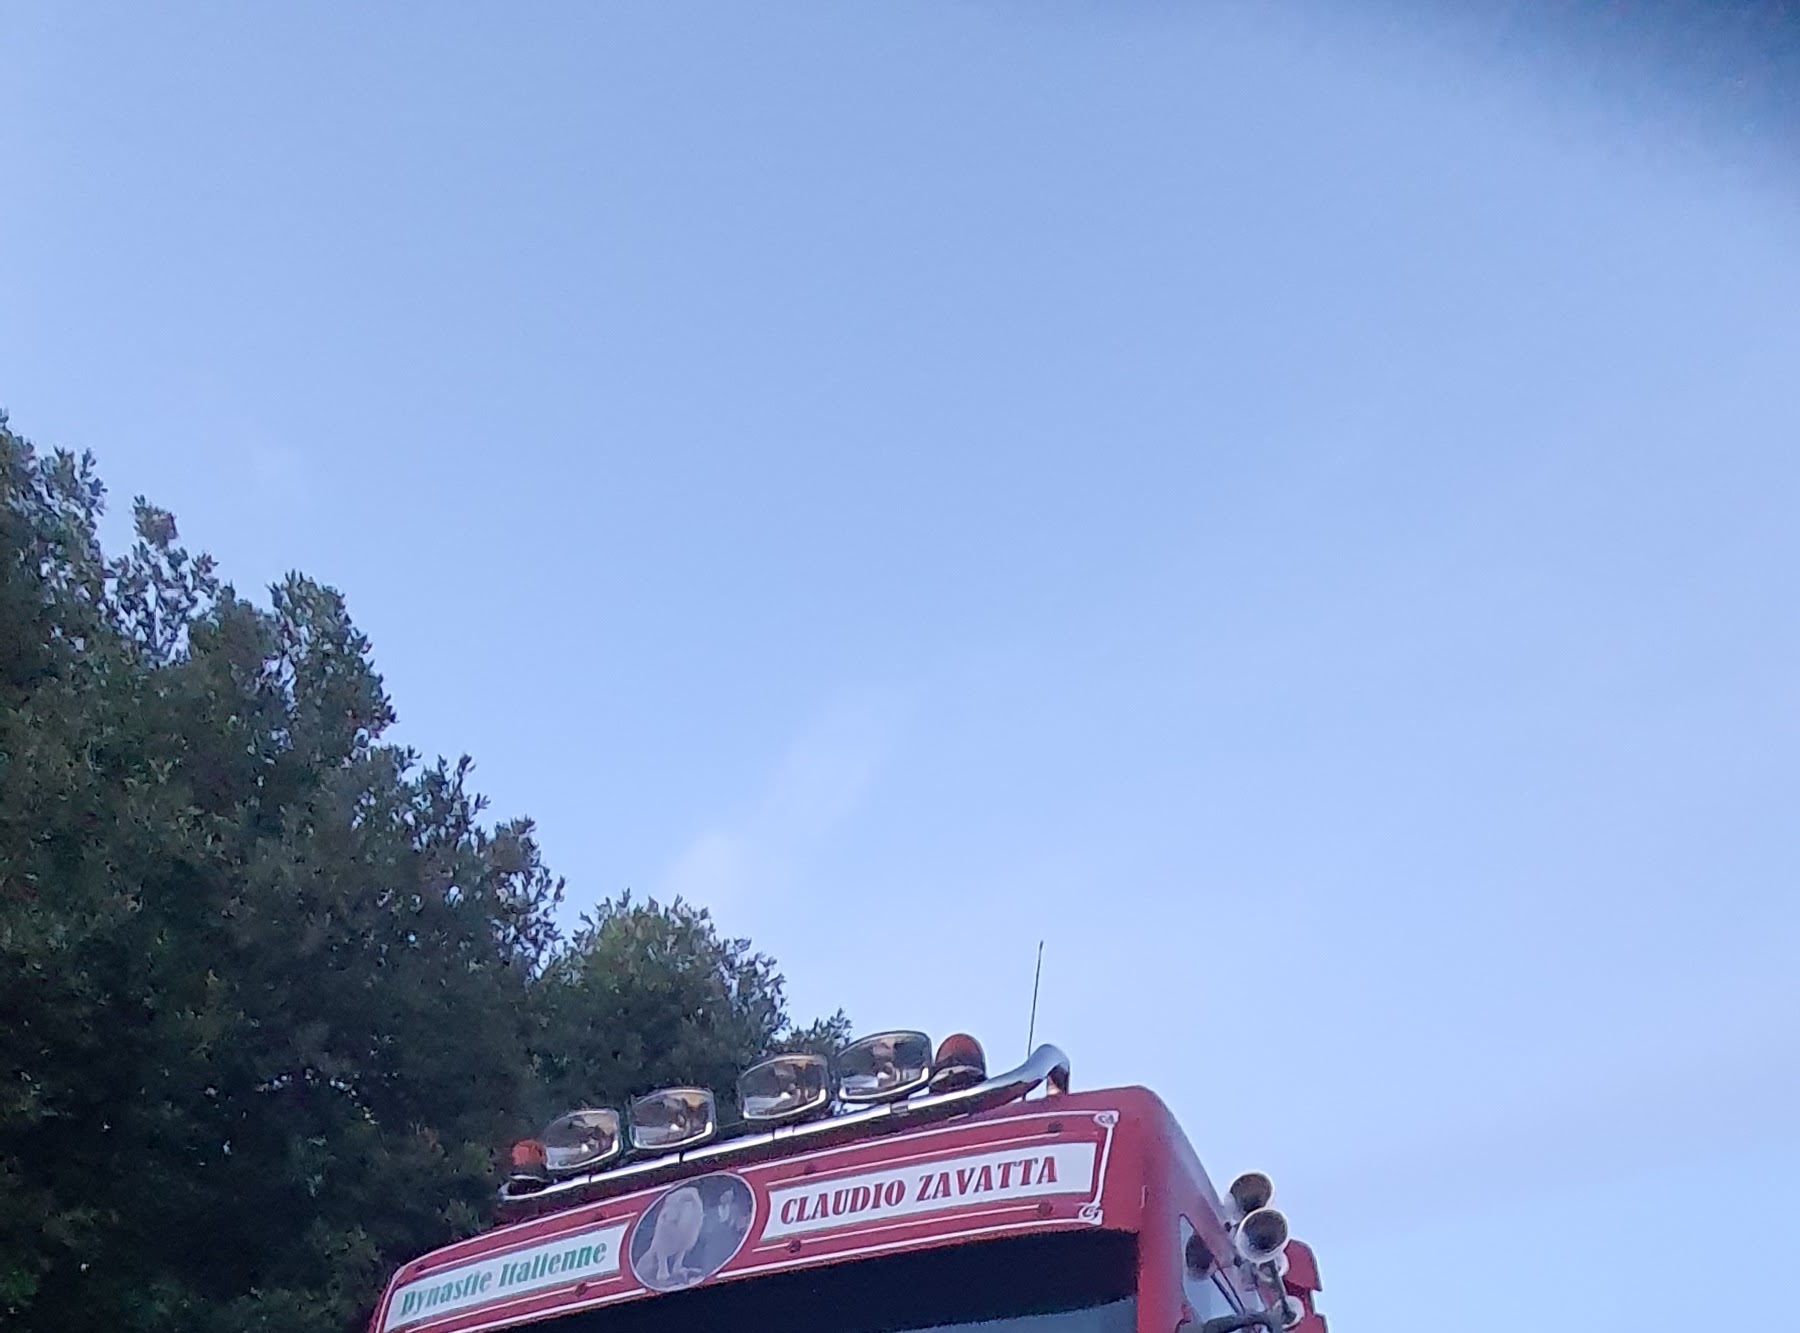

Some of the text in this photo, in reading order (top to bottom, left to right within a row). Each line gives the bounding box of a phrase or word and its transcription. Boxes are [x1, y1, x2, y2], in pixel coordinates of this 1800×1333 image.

[780, 1155, 1058, 1225] CLAUDIO ZAVATTA
[400, 1241, 608, 1318] Dynastie Italienne
